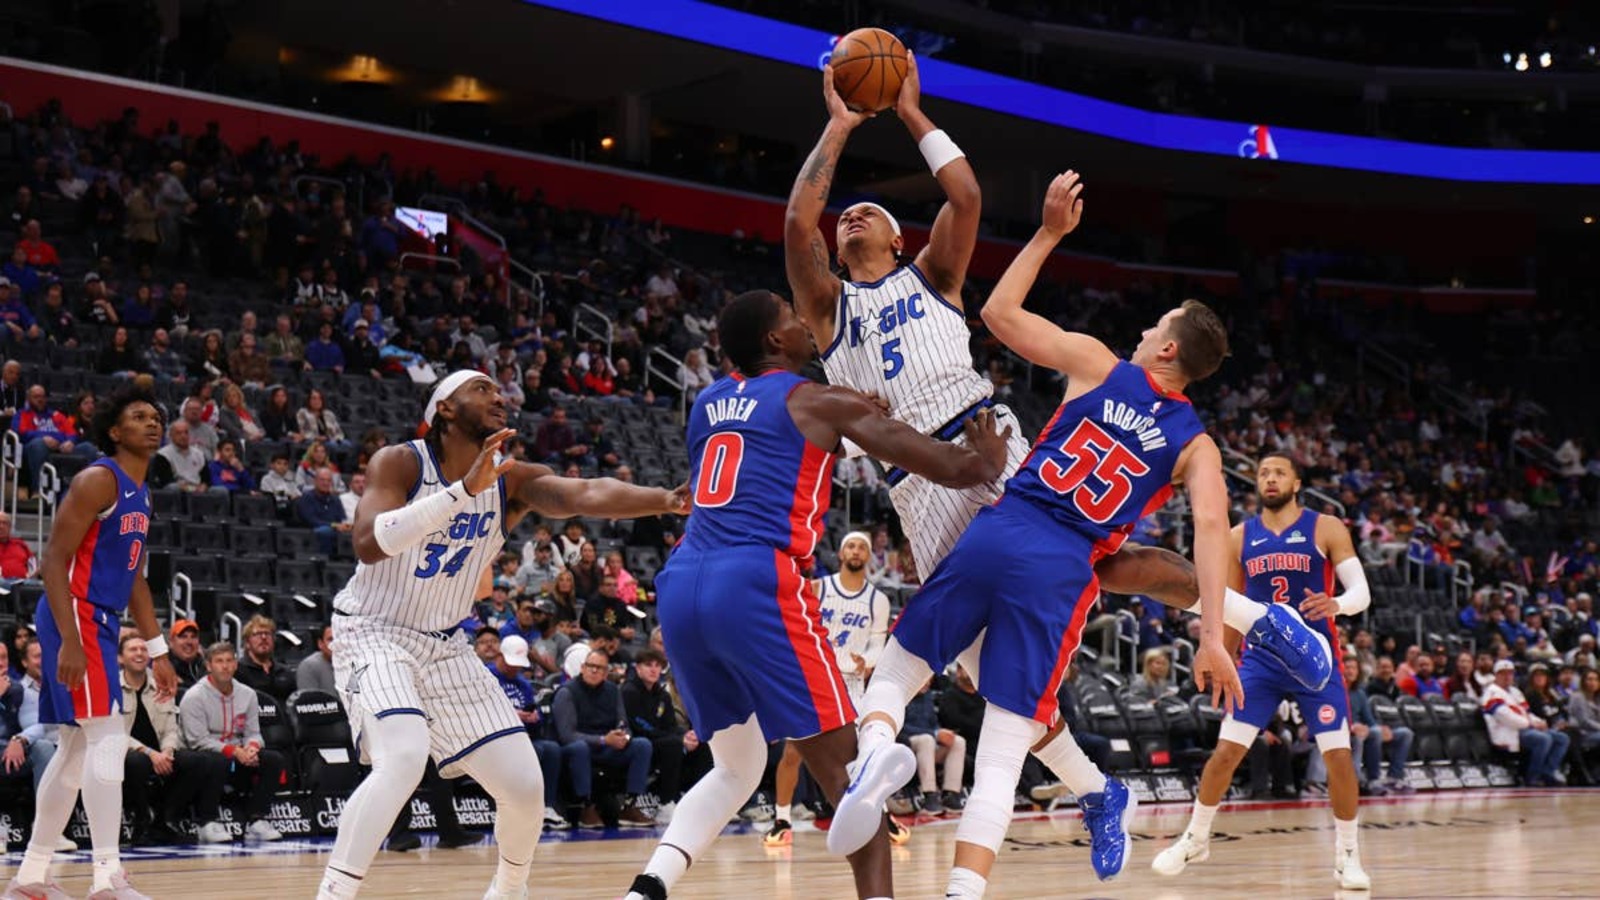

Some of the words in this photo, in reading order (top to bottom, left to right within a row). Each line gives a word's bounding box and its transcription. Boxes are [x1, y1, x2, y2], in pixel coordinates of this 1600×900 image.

[881, 337, 904, 380] 5
[705, 397, 758, 427] DUREN
[694, 431, 744, 507] 0
[1038, 417, 1151, 523] 55
[127, 539, 142, 570] 9
[414, 542, 473, 579] 34
[1246, 552, 1311, 577] DETROIT
[1271, 576, 1290, 604] 2
[265, 801, 301, 819] ittle
[452, 797, 490, 812] Little
